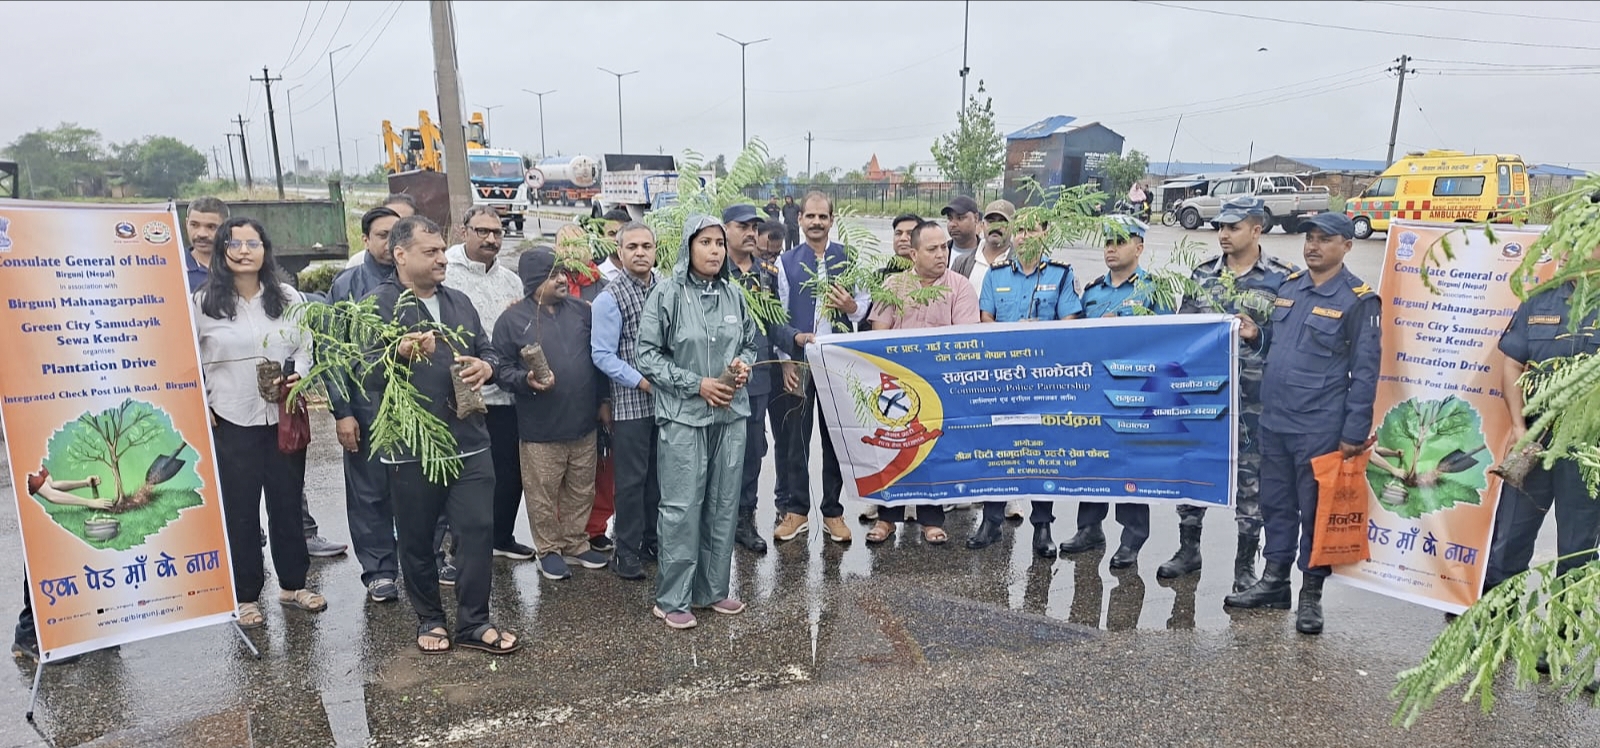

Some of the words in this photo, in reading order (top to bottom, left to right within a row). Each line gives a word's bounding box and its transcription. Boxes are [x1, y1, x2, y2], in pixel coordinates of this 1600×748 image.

[1429, 211, 1478, 219] AMBULANCE
[65, 255, 116, 266] General
[119, 255, 132, 266] of
[136, 254, 166, 266] India
[56, 271, 84, 279] Birgunj
[86, 270, 115, 279] (Nepal)
[1449, 269, 1492, 281] General
[1495, 271, 1508, 282] of
[1437, 280, 1461, 290] Birgunj
[1462, 282, 1488, 291] (Nepal)
[8, 298, 56, 310] Birgunj
[60, 295, 164, 308] Mahanagarpalika
[1392, 297, 1428, 310] Birgunj
[21, 322, 62, 333] Green
[66, 320, 90, 332] City
[94, 317, 160, 330] Samudayik
[1394, 317, 1424, 329] Green
[1428, 320, 1449, 334] City
[1451, 324, 1504, 337] Samudayi
[56, 336, 90, 346] Sewa
[93, 333, 138, 344] Kendra
[1416, 332, 1442, 344] Sewa
[1445, 336, 1484, 348] Kendra
[82, 348, 115, 356] organises
[886, 345, 898, 354] हर
[944, 342, 950, 351] र
[984, 349, 1006, 360] नेपाल
[1010, 348, 1031, 358] प्रहरी
[42, 360, 117, 375] Plantation
[121, 357, 156, 369] Drive
[1110, 362, 1133, 372] नेपाल
[1135, 363, 1156, 372] प्रहरी
[1396, 352, 1456, 369] Plantation
[1460, 360, 1491, 373] Drive
[1031, 360, 1093, 379] साझेदारी
[950, 385, 1002, 395] Community
[1006, 383, 1034, 392] Police
[1037, 382, 1091, 392] Partnership
[1170, 381, 1202, 390] स्थानीय
[1400, 375, 1422, 386] Check
[1424, 378, 1441, 389] Post
[1444, 382, 1459, 391] Link
[4, 392, 56, 404] Integrated
[58, 388, 88, 398] Check
[90, 388, 111, 396] Post
[113, 386, 132, 394] Link
[165, 380, 197, 390] Birgunj
[1116, 395, 1145, 403] समुदाय
[1152, 408, 1191, 416] सामाजिक
[1040, 411, 1102, 427] कार्यक्रम
[1118, 420, 1150, 430] विद्यालय
[1013, 438, 1044, 447] आयोजक
[974, 449, 994, 459] सिटी
[996, 448, 1042, 459] सामुदायिक
[1044, 448, 1066, 458] प्रहरी
[1069, 448, 1086, 458] सेवा
[1086, 448, 1110, 458] केन्द्र
[1368, 519, 1392, 545] पेड
[1422, 531, 1438, 557] के
[1444, 542, 1479, 566] नाम
[38, 575, 79, 606] एक
[83, 564, 116, 591] पेड
[154, 552, 178, 578] के
[184, 550, 220, 574] नाम
[97, 605, 184, 628] www.cgibirgunj.gov.in
